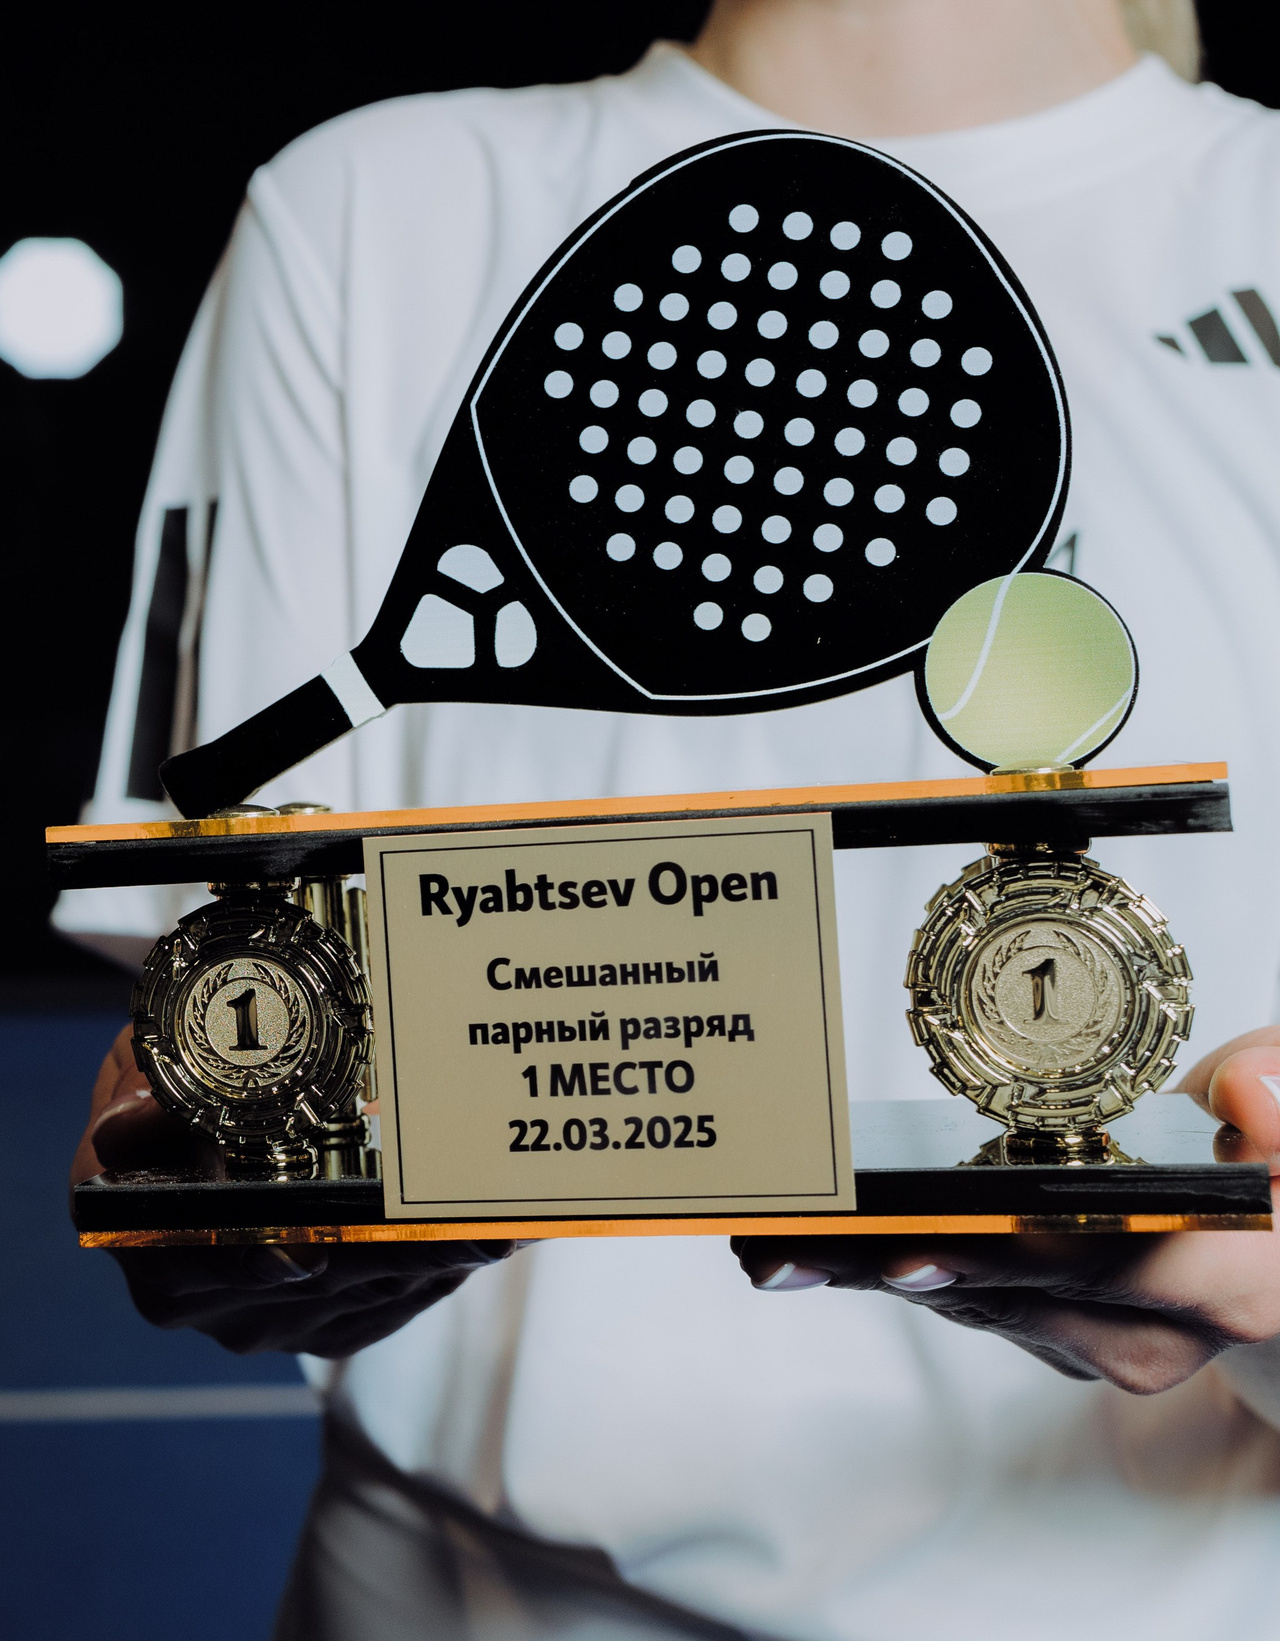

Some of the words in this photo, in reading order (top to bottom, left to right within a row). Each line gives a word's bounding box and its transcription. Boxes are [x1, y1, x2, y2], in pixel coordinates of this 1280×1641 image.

[418, 868, 636, 928] Ryabtsev
[647, 861, 779, 917] Open
[486, 951, 720, 991] Смешанный
[1020, 956, 1069, 1026] 1
[225, 987, 269, 1053] 1
[468, 1010, 610, 1054] парный
[619, 1012, 755, 1051] разряд
[521, 1064, 539, 1098] 1
[549, 1059, 696, 1097] МЕСТО
[508, 1114, 718, 1153] 22.03.2025
